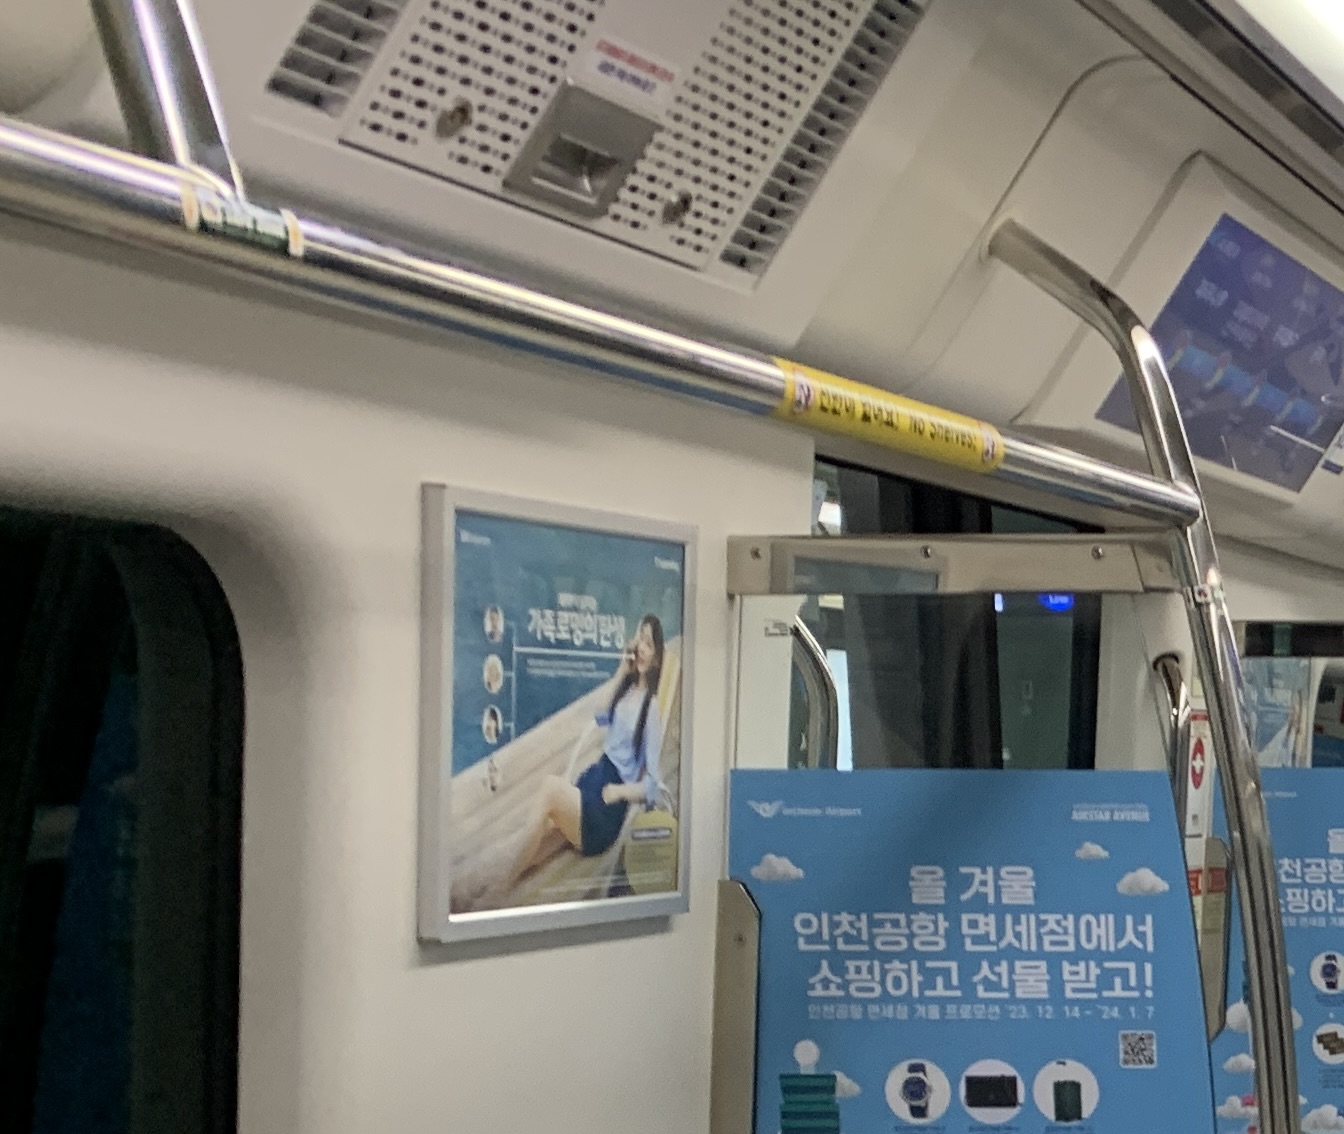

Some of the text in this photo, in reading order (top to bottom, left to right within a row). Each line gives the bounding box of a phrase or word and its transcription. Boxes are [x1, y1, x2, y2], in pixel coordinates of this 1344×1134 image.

[910, 865, 1036, 905] 올 겨울
[793, 911, 1155, 952] 인천공항 면세점에서
[807, 960, 1154, 999] 쇼핑하고 선물 받고!
